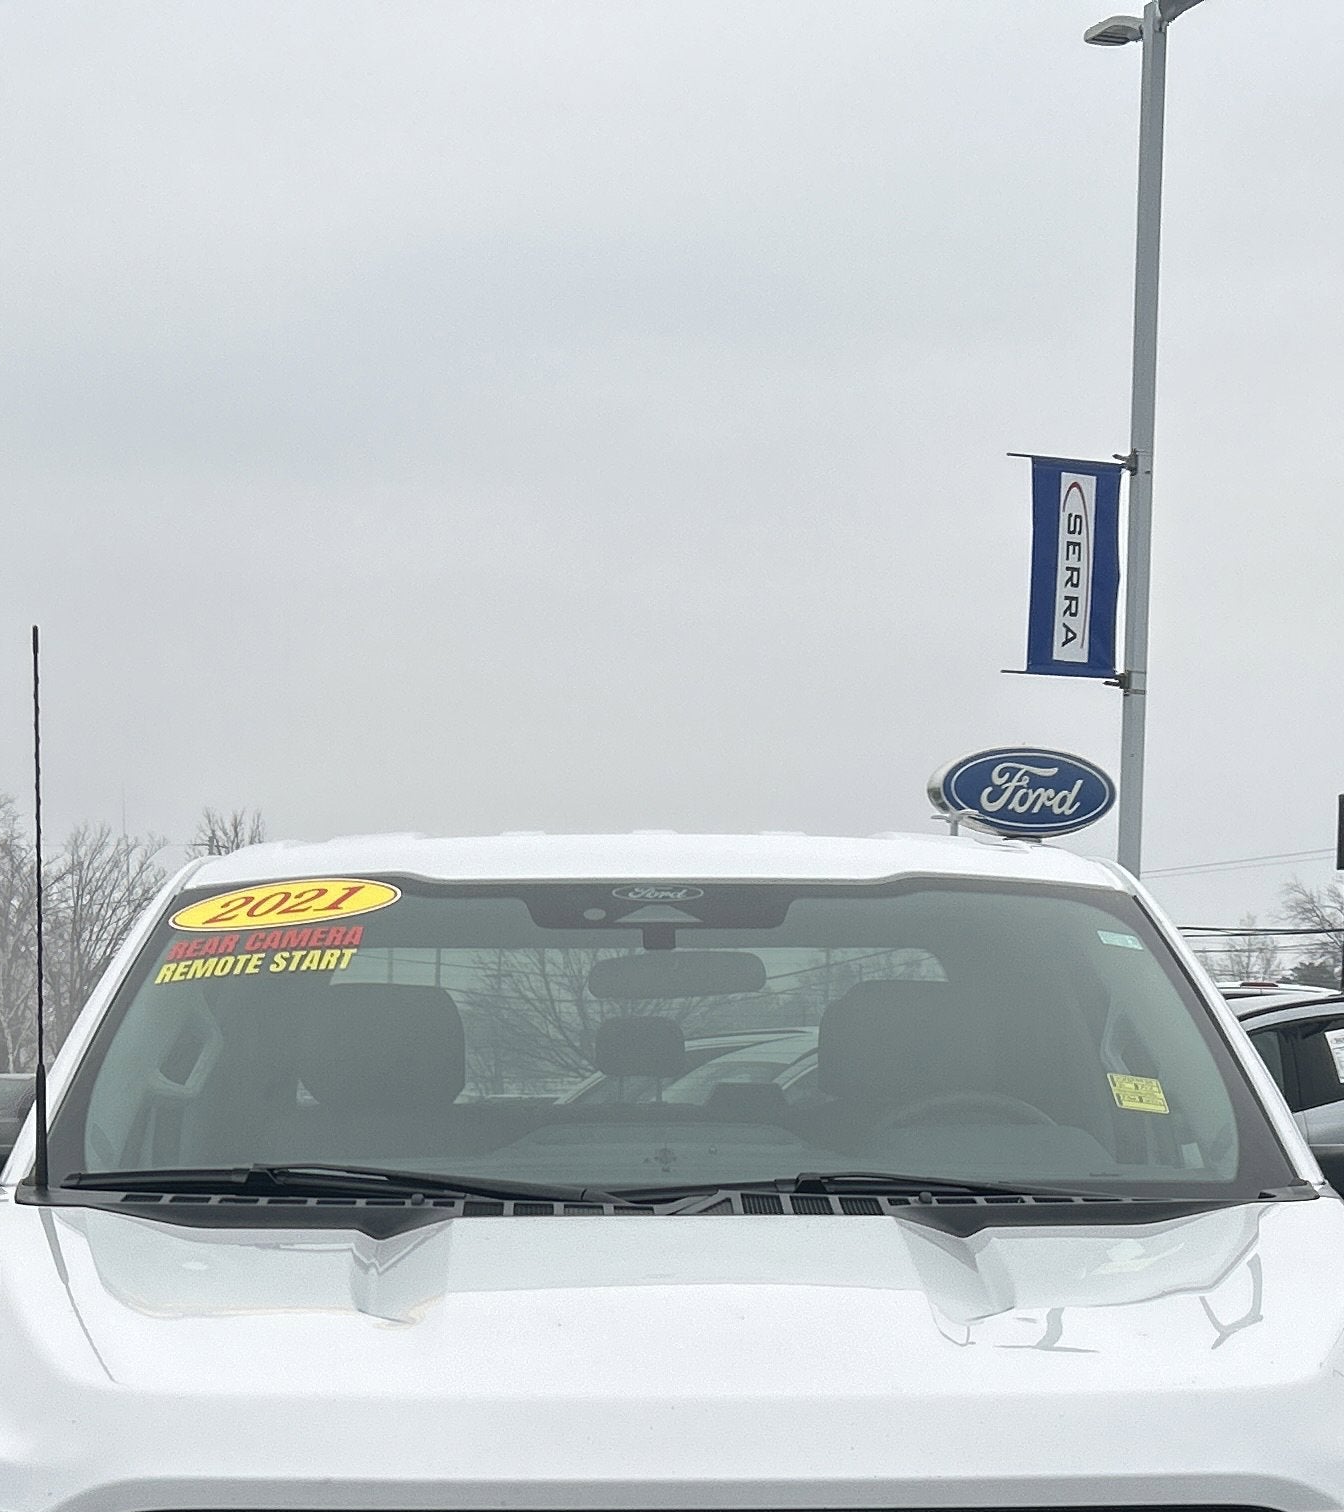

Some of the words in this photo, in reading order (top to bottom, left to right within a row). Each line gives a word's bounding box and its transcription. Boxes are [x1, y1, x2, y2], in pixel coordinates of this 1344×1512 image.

[1060, 511, 1083, 649] SERRA
[979, 761, 1083, 816] Ford
[201, 885, 366, 925] 2021
[627, 886, 688, 899] Ford
[166, 933, 241, 961] REAR
[244, 926, 365, 952] CAMERA
[154, 952, 266, 985] REMOTE
[269, 947, 358, 973] START
